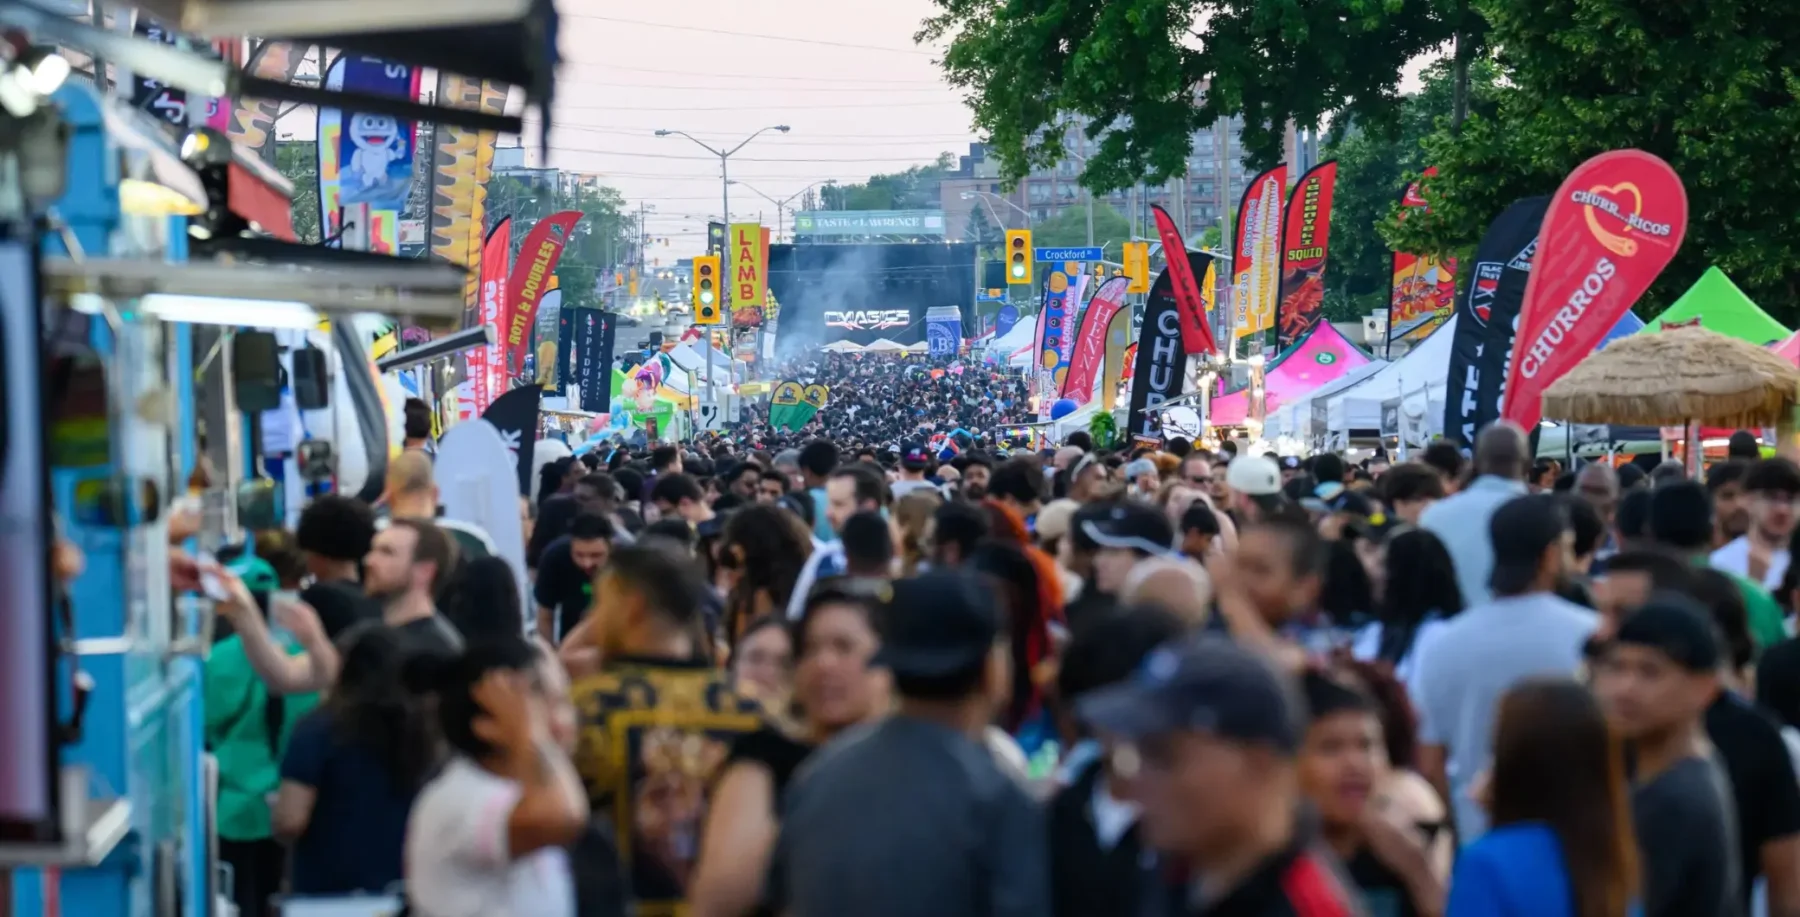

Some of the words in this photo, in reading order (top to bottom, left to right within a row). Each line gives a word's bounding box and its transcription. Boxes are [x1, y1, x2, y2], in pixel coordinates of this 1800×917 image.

[817, 218, 850, 228] TASTE
[860, 217, 920, 228] LAWRENCE
[521, 240, 556, 301] DOUBLES
[738, 229, 757, 300] LAMB
[1045, 250, 1086, 260] Crockford
[1288, 247, 1323, 261] SQUID
[517, 301, 531, 313] &
[1238, 273, 1249, 322] POTATO
[1520, 257, 1615, 378] CHURROS
[508, 315, 528, 346] ROTI
[1061, 316, 1073, 361] DALGONA
[581, 313, 593, 409] ASPIDUCCI
